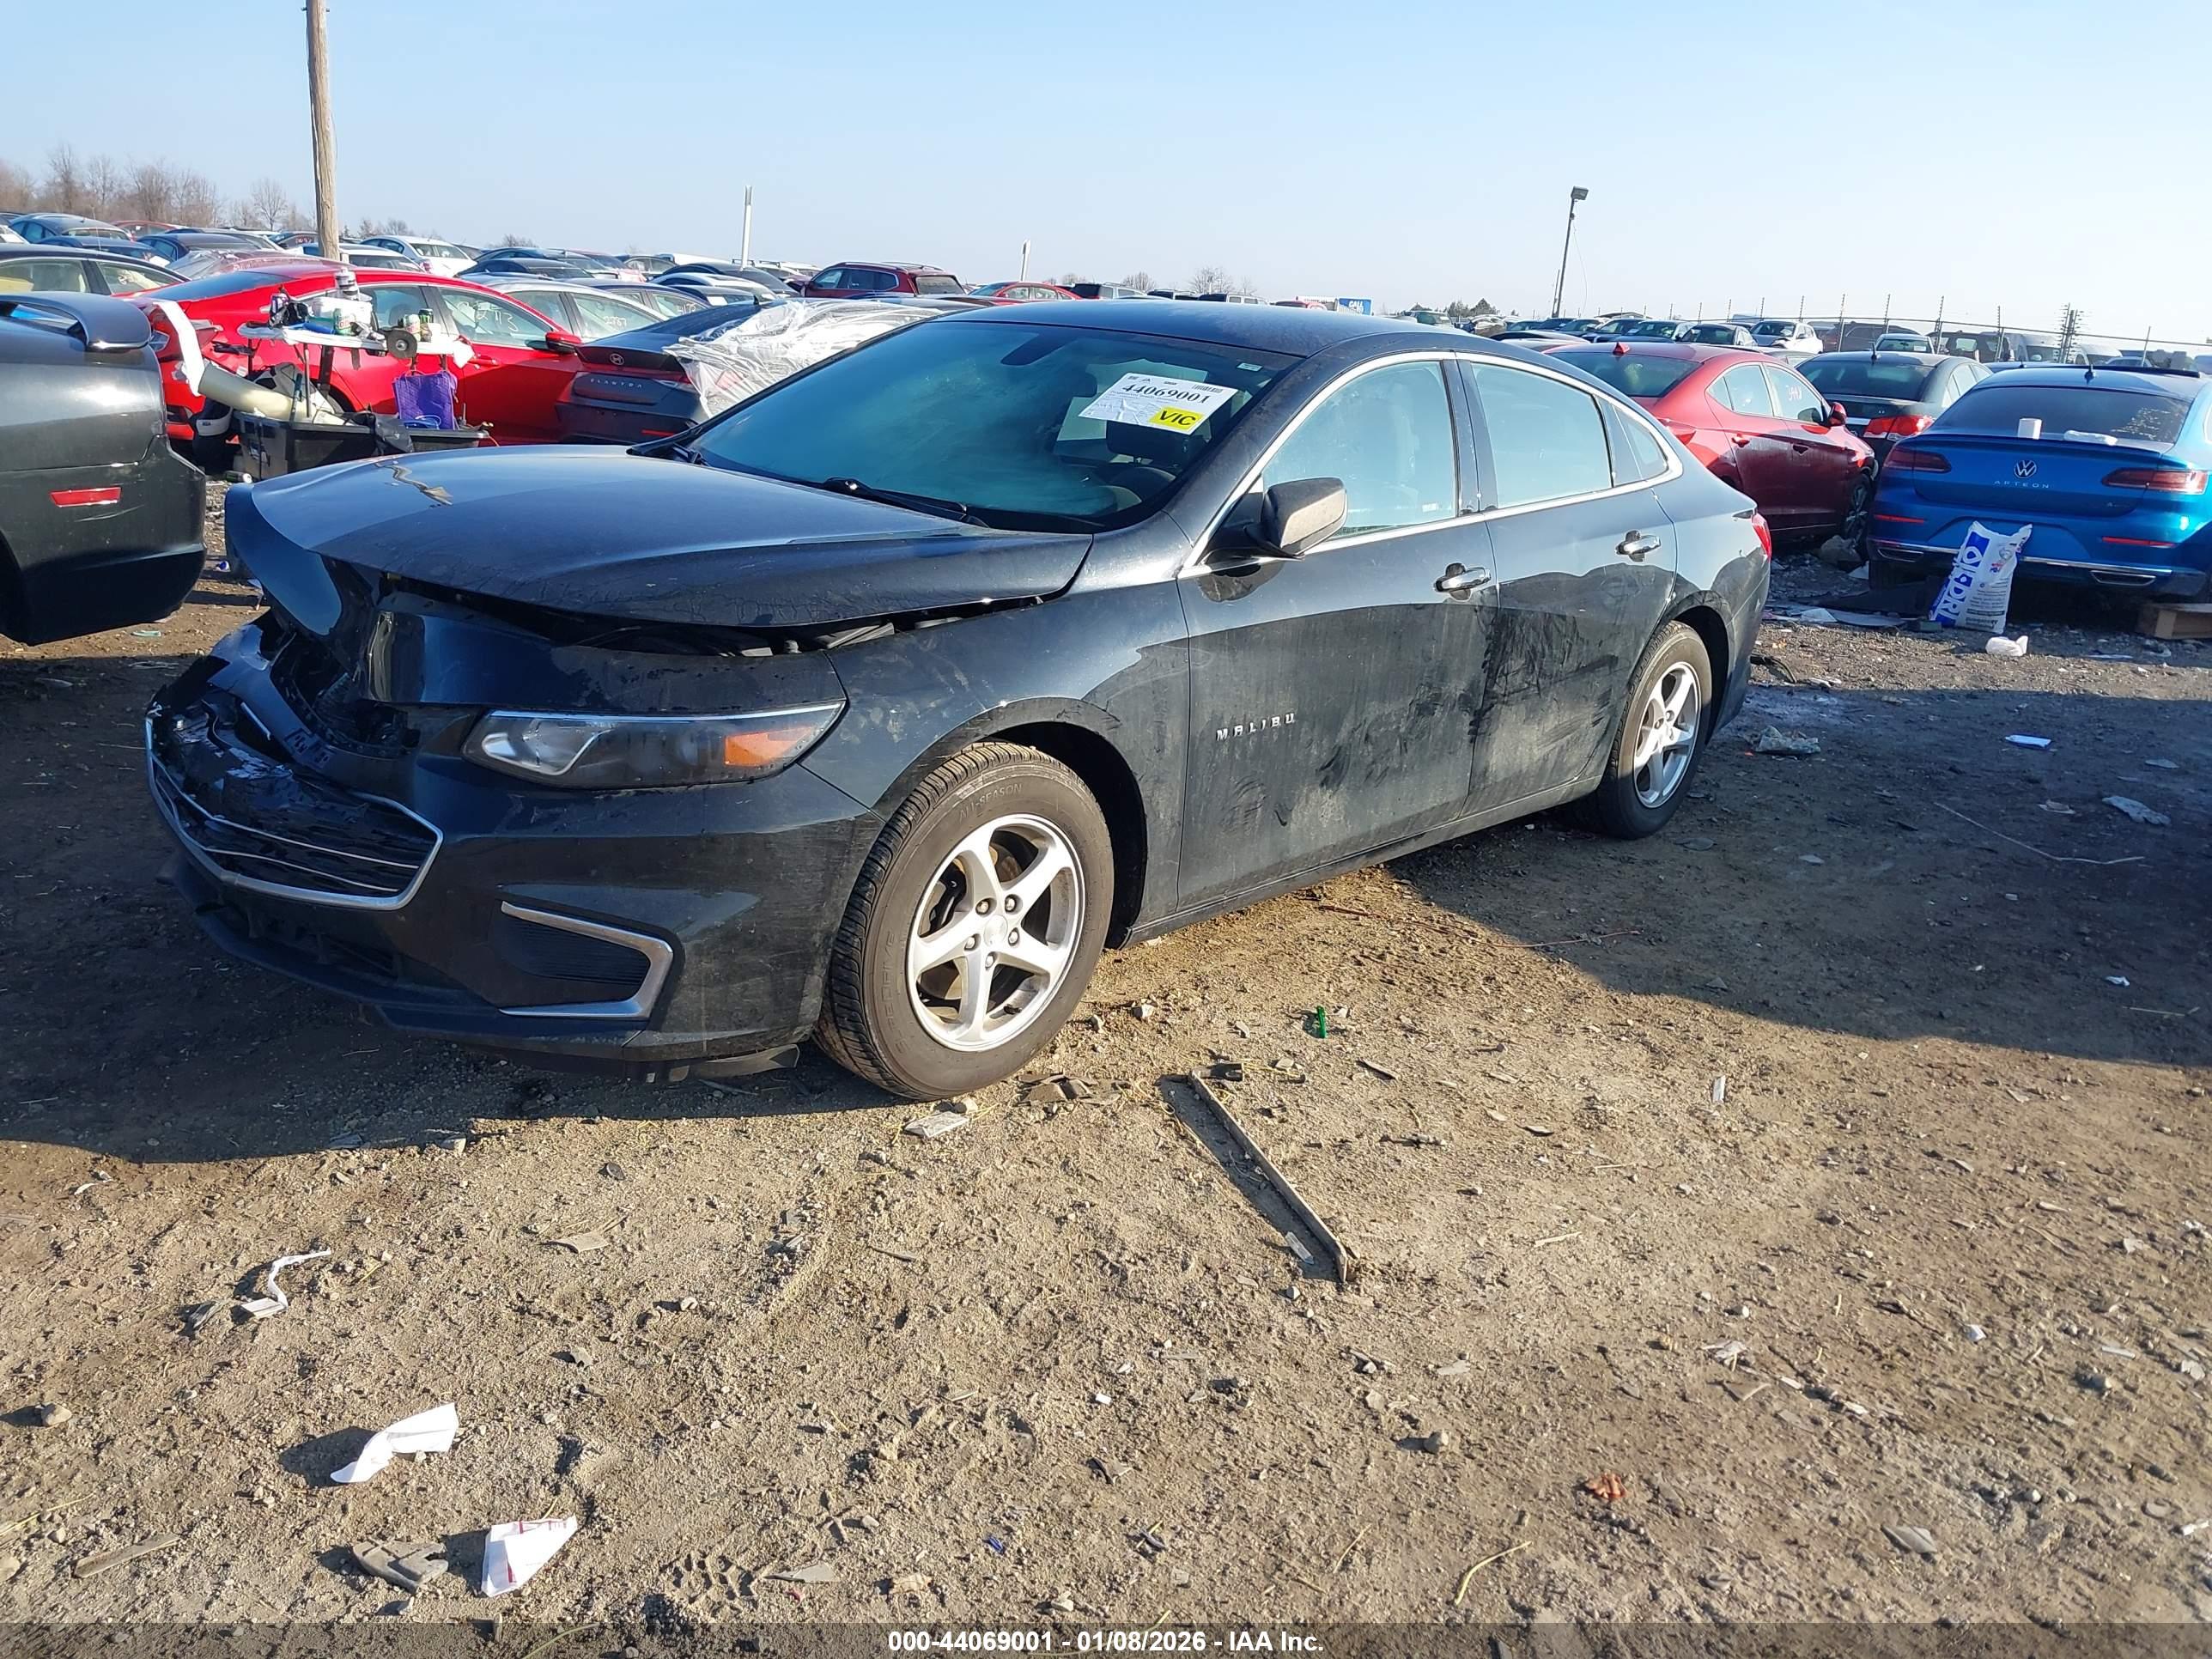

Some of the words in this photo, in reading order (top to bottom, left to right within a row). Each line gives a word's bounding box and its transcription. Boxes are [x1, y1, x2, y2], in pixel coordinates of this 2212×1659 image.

[1122, 383, 1211, 404] 44069001
[1159, 410, 1196, 426] VIC
[1994, 479, 2049, 489] ARTEON
[1216, 713, 1295, 741] MALIBU
